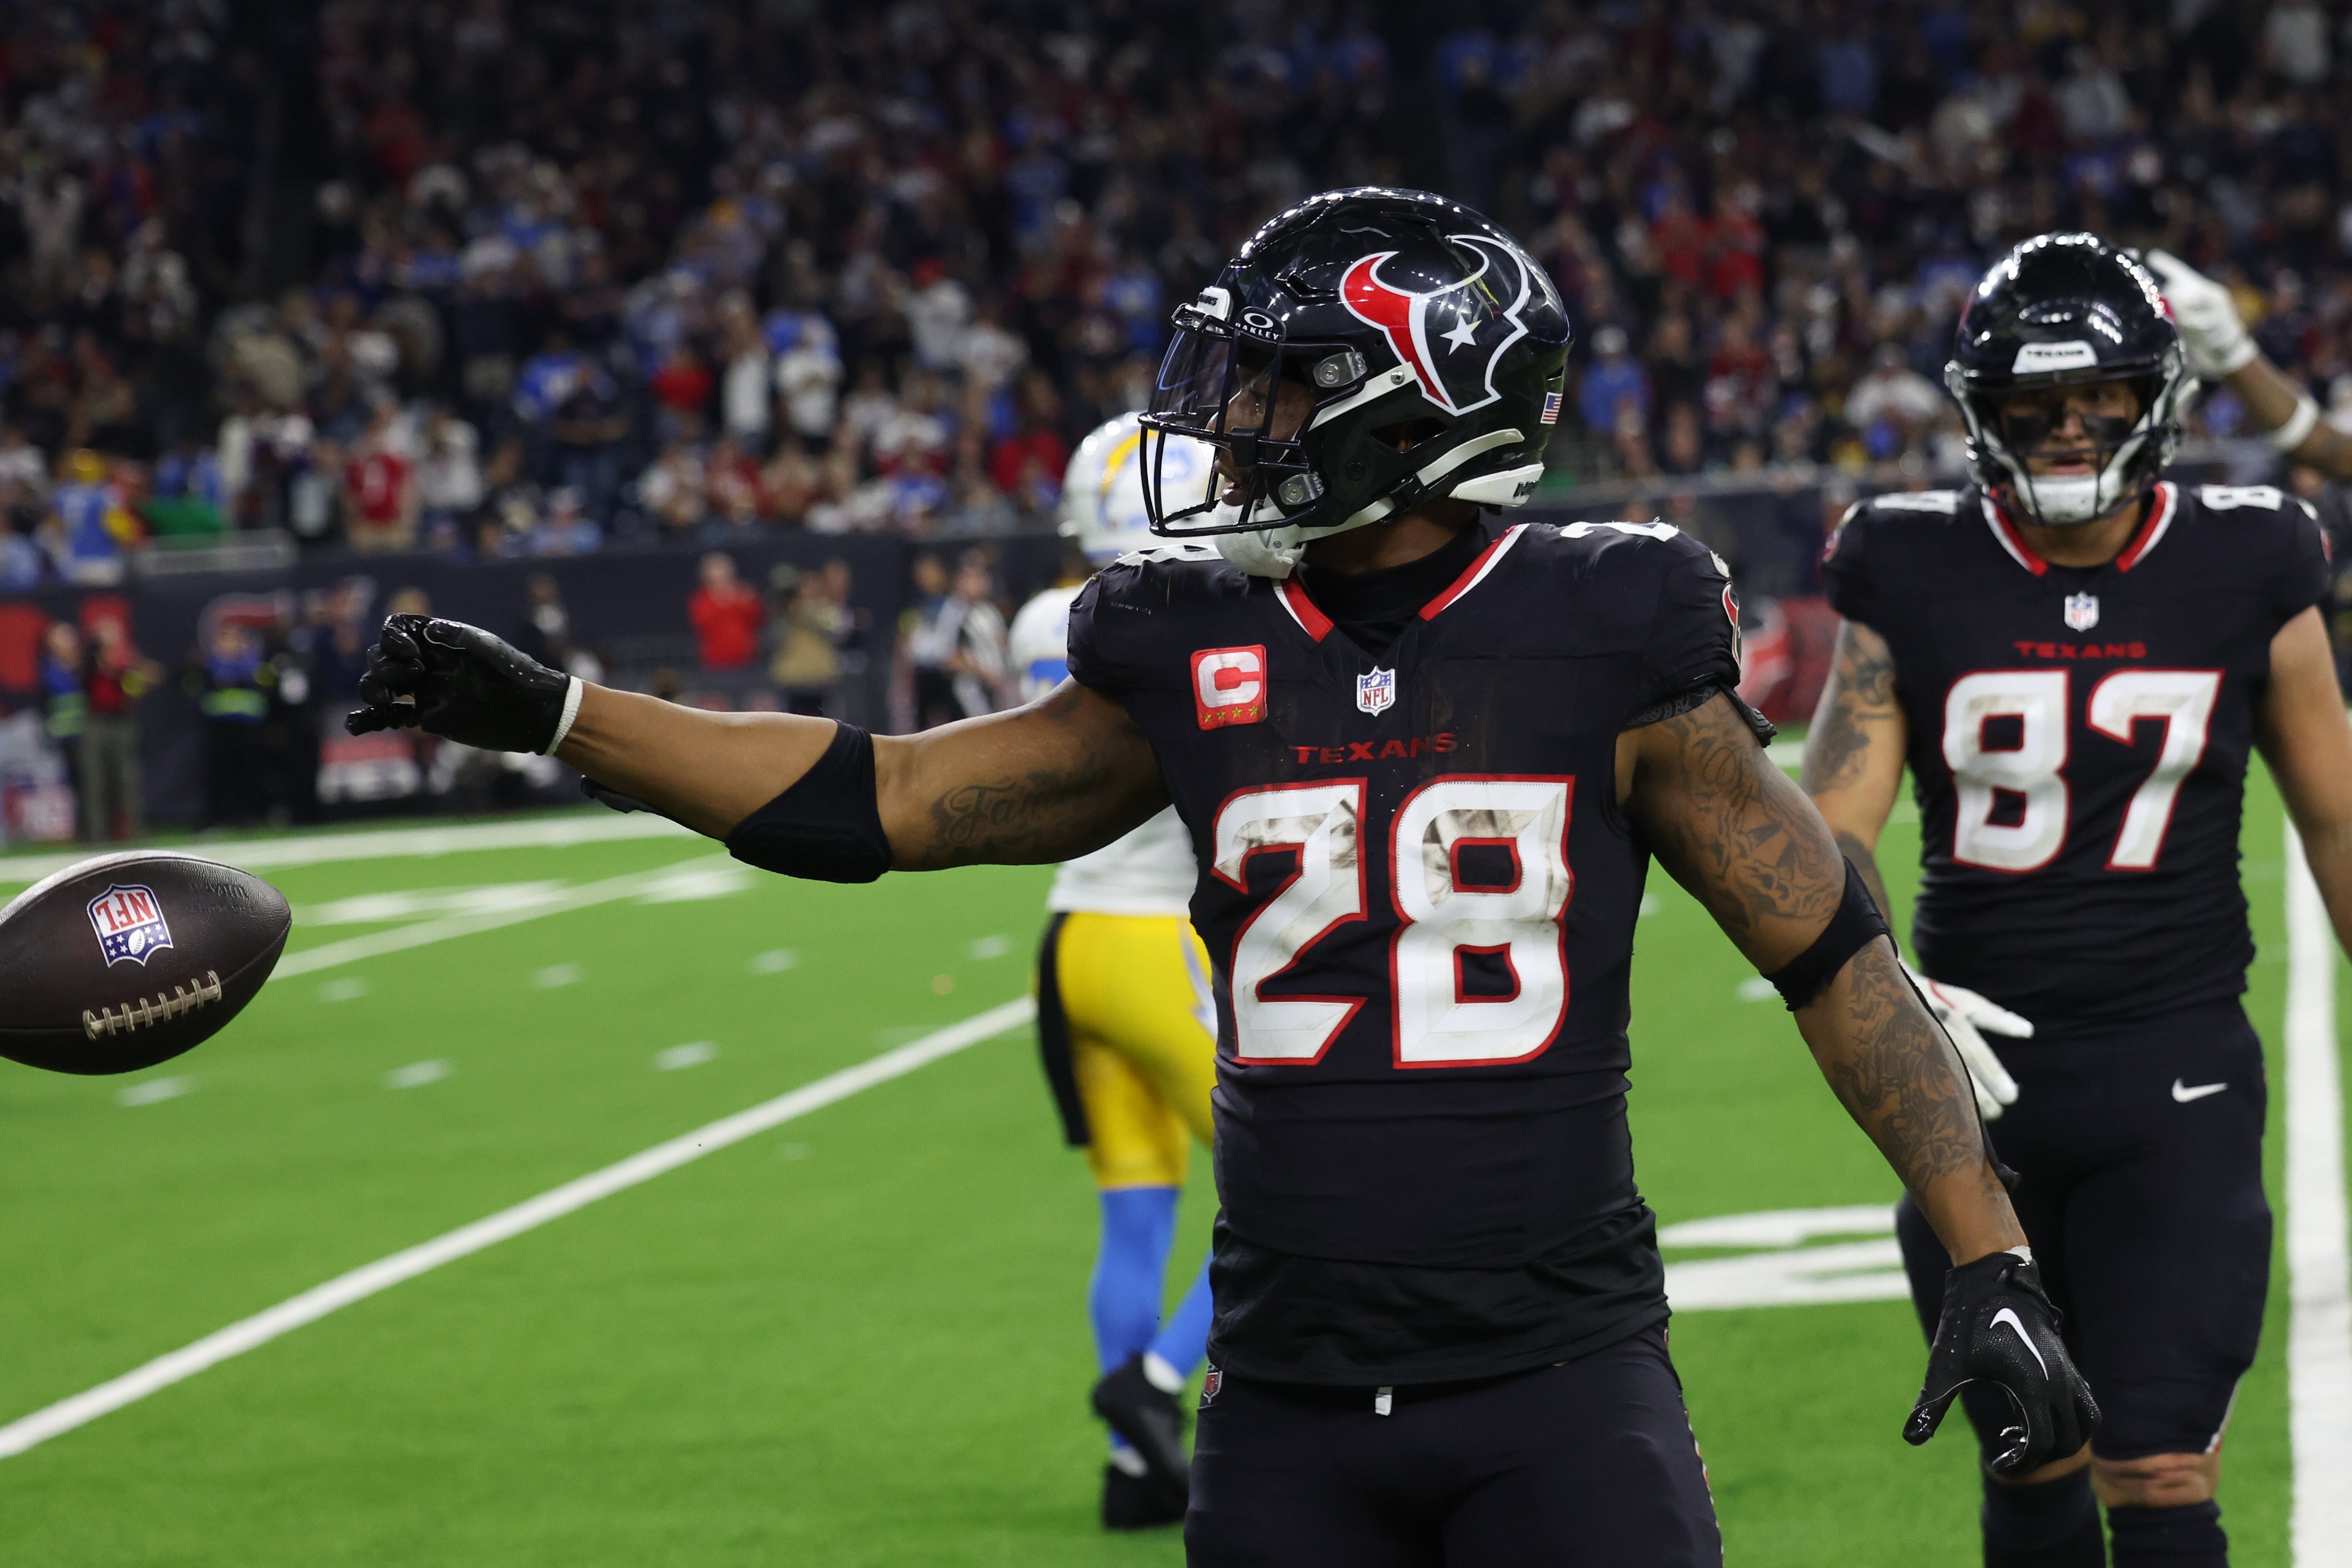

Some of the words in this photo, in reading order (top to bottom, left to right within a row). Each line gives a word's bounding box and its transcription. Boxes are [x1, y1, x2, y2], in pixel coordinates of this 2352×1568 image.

[2013, 641, 2148, 659] TEXANS
[1198, 651, 1260, 708] C
[1363, 687, 1388, 706] NFL
[1288, 733, 1458, 764] TEXANS
[1942, 668, 2226, 873] 87
[95, 892, 155, 931] NFL
[1211, 774, 1575, 1069] 28
